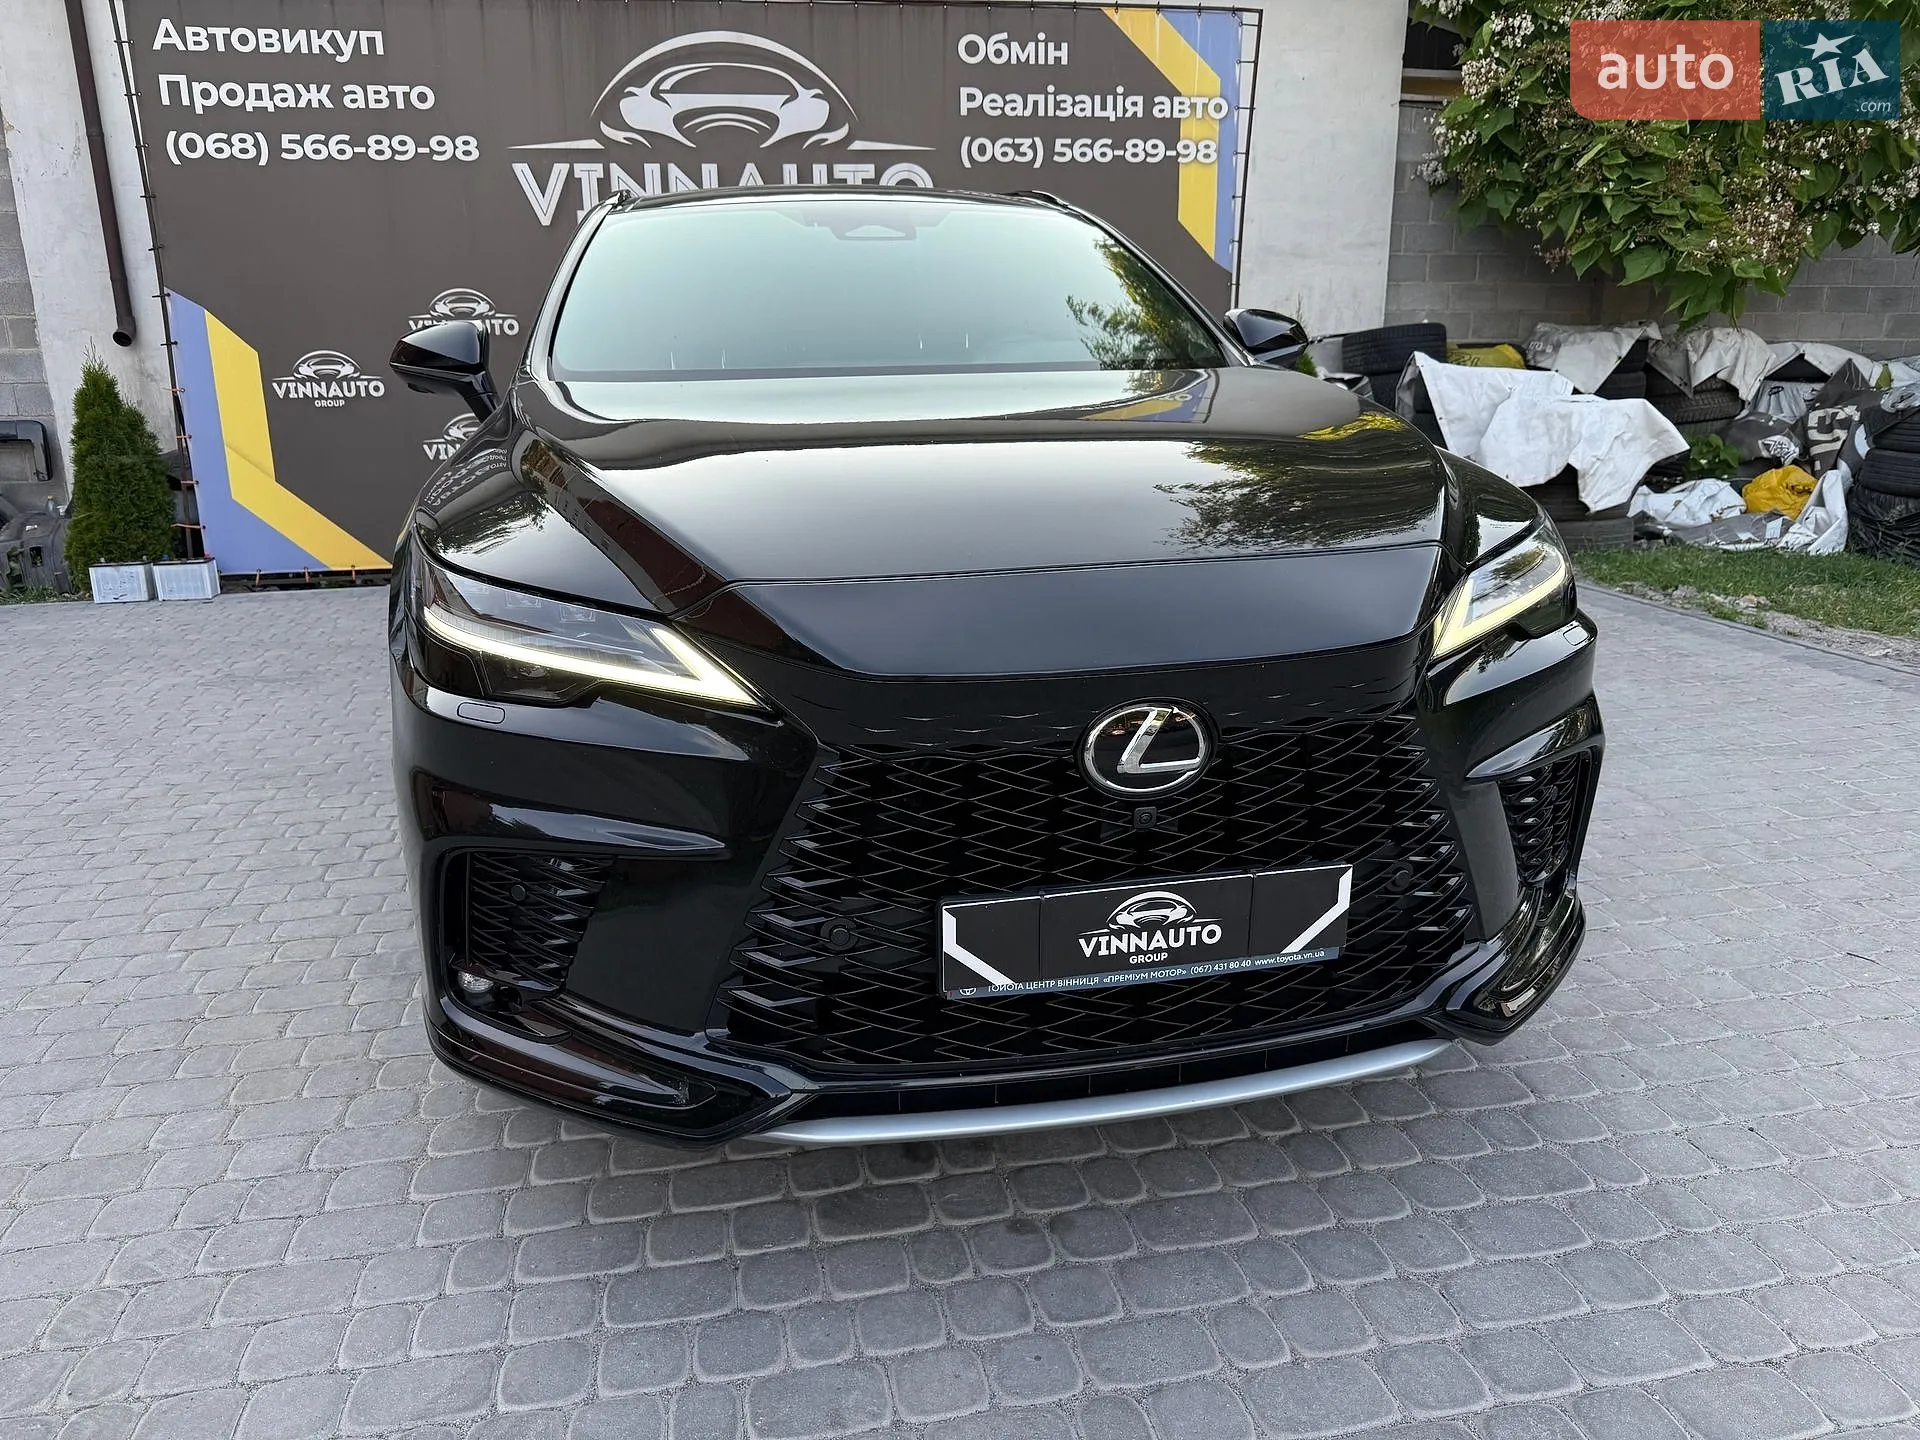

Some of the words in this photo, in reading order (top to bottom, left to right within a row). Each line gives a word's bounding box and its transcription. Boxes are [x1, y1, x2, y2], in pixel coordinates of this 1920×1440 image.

[152, 18, 385, 63] Автовикуп
[957, 31, 1069, 66] Обмін
[158, 73, 335, 115] Продаж
[342, 84, 436, 110] авто
[959, 84, 1144, 122] Реалізація
[1152, 97, 1229, 120] авто
[165, 130, 269, 166] (068)
[280, 133, 480, 162] 566-89-98
[960, 135, 1044, 168] (063)
[1053, 138, 1218, 165] 566-89-98
[271, 380, 385, 400] VINNAUTO
[313, 398, 346, 408] GROUP
[1078, 923, 1222, 958] VINNAUTO
[1026, 980, 1056, 991] ЦЕНТР
[1057, 976, 1099, 988] ВІННИЦЯ
[1190, 964, 1212, 975] (067)
[1213, 962, 1228, 971] 431
[1229, 960, 1240, 969] 80
[1241, 959, 1251, 968] 40
[1254, 950, 1325, 966] www.toyota.vn.ua
[1129, 952, 1169, 965] GROUP
